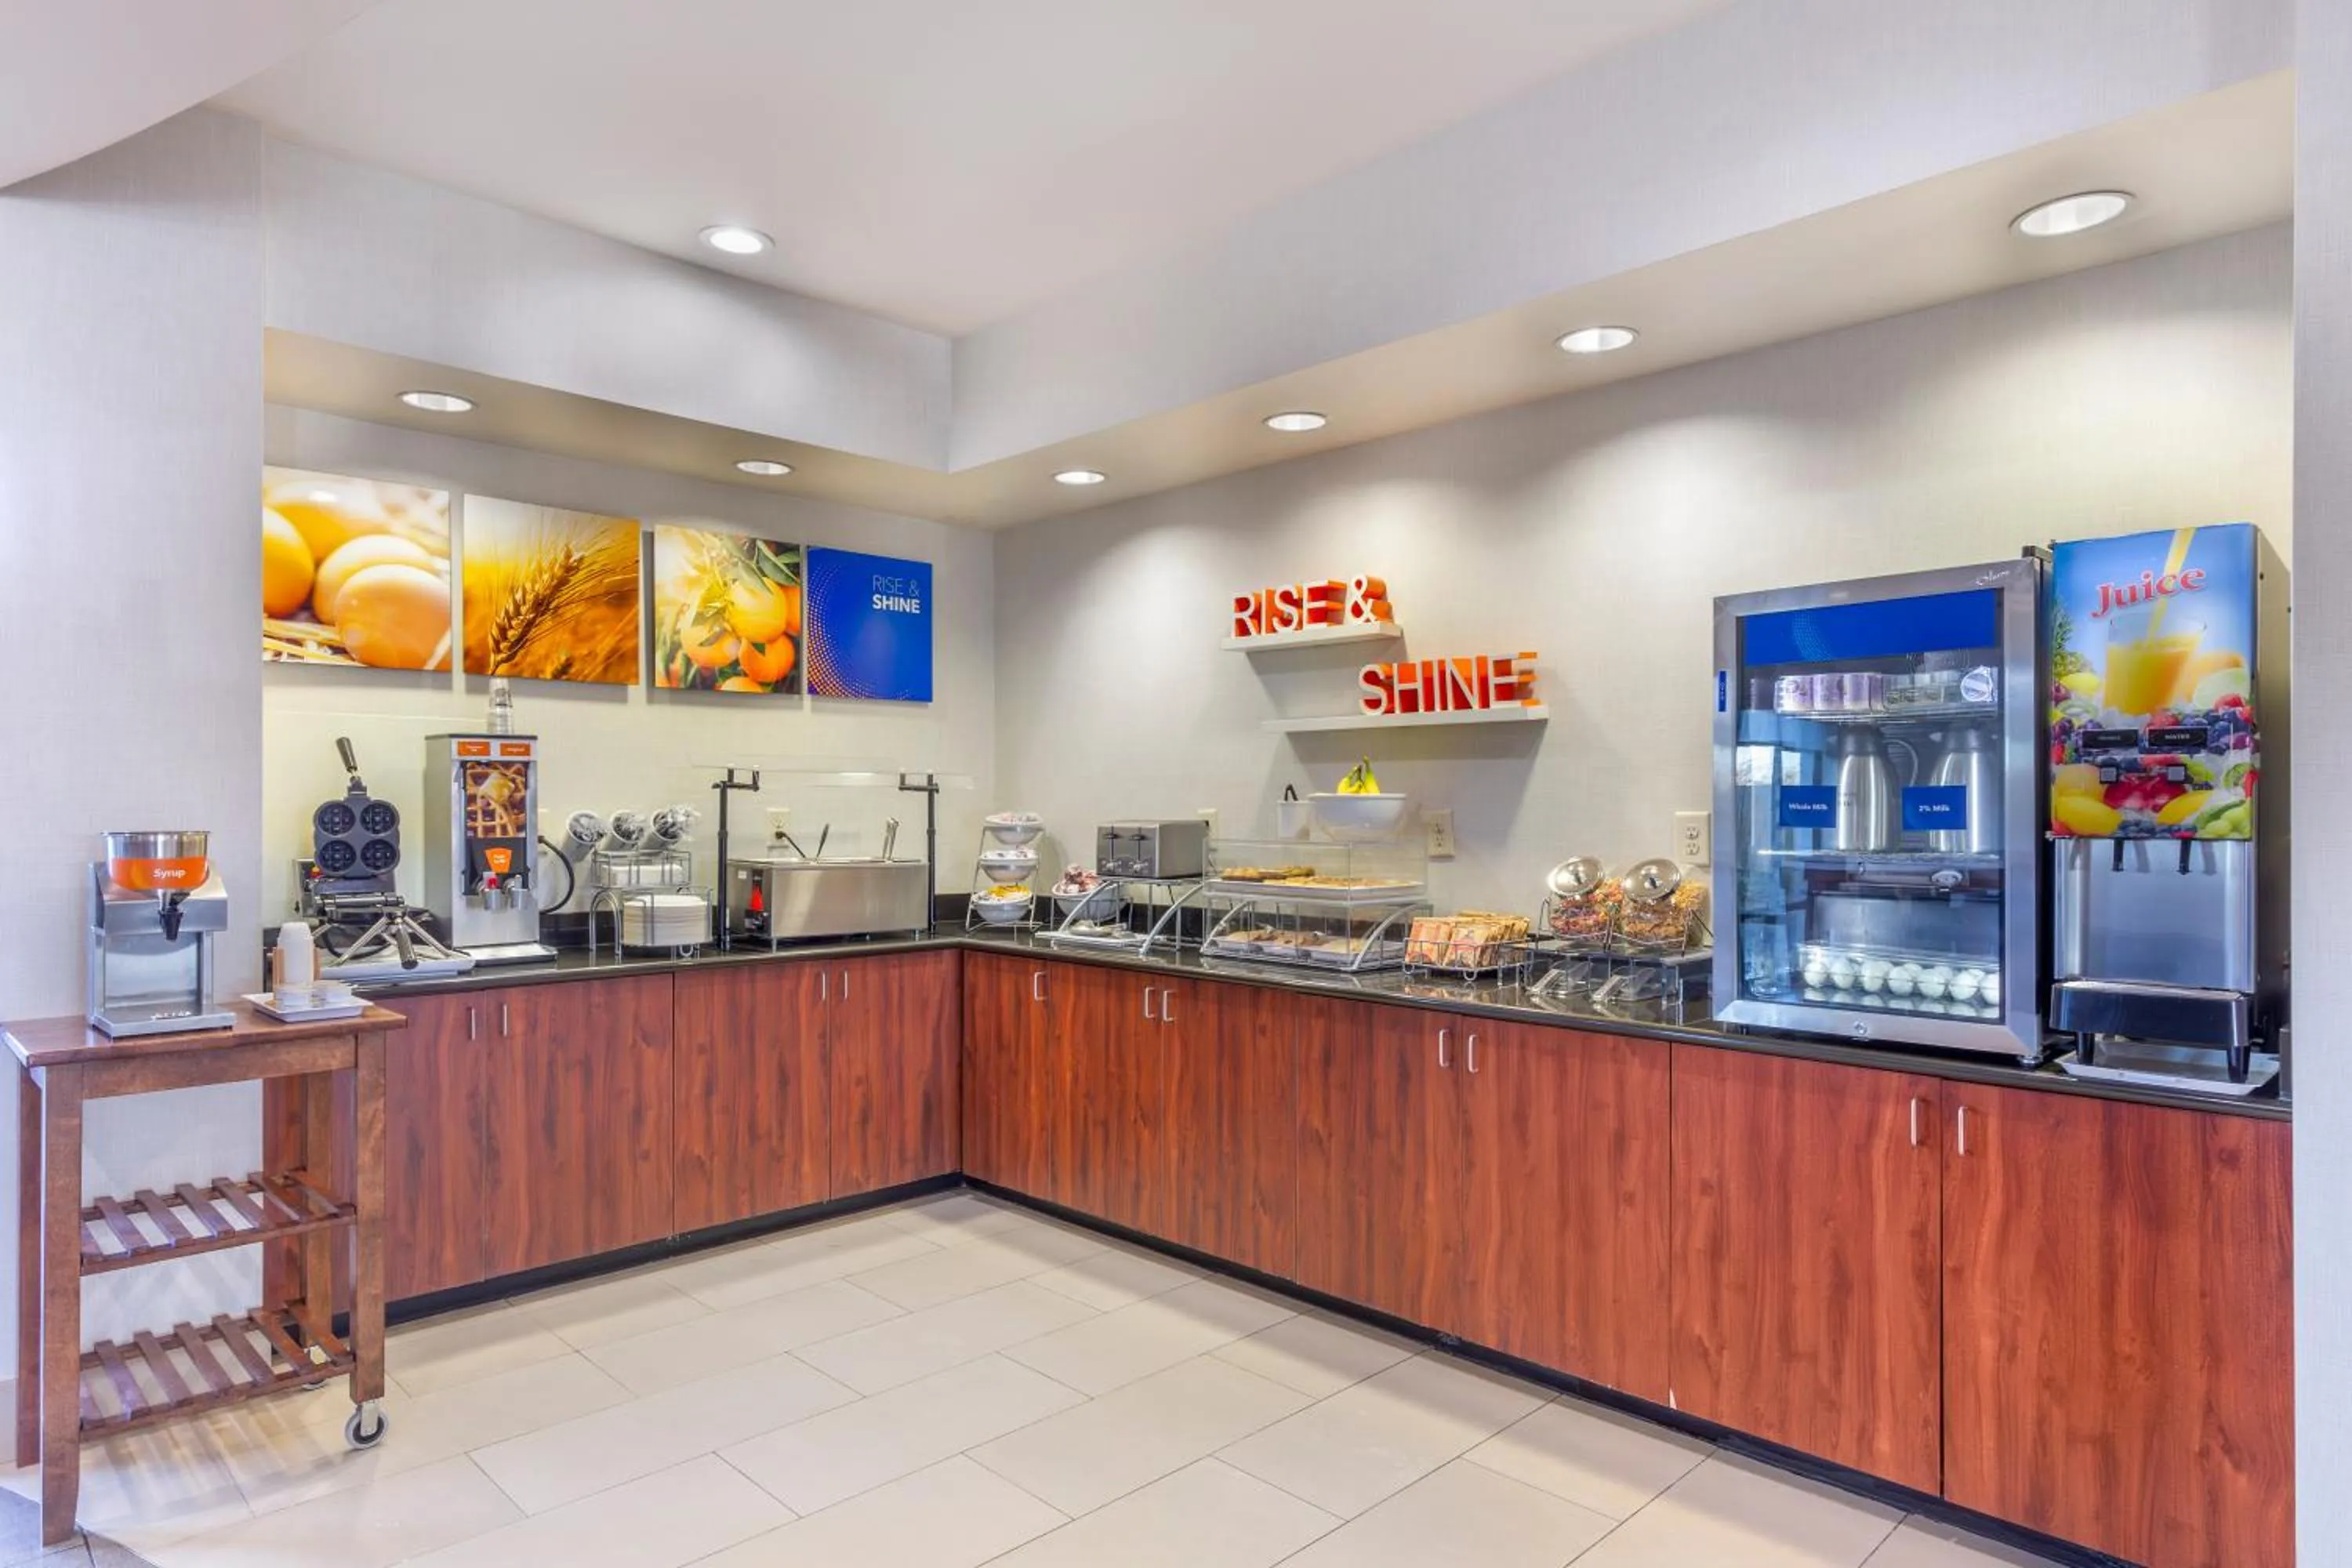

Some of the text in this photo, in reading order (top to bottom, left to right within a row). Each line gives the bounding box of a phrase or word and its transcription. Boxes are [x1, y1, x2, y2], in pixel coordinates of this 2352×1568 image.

[873, 575, 920, 597] RISE &
[873, 593, 921, 614] SHINE
[2090, 568, 2208, 619] Juice
[1232, 574, 1385, 639] RISE &
[1358, 653, 1537, 716] SHINE
[153, 867, 187, 879] Syrup
